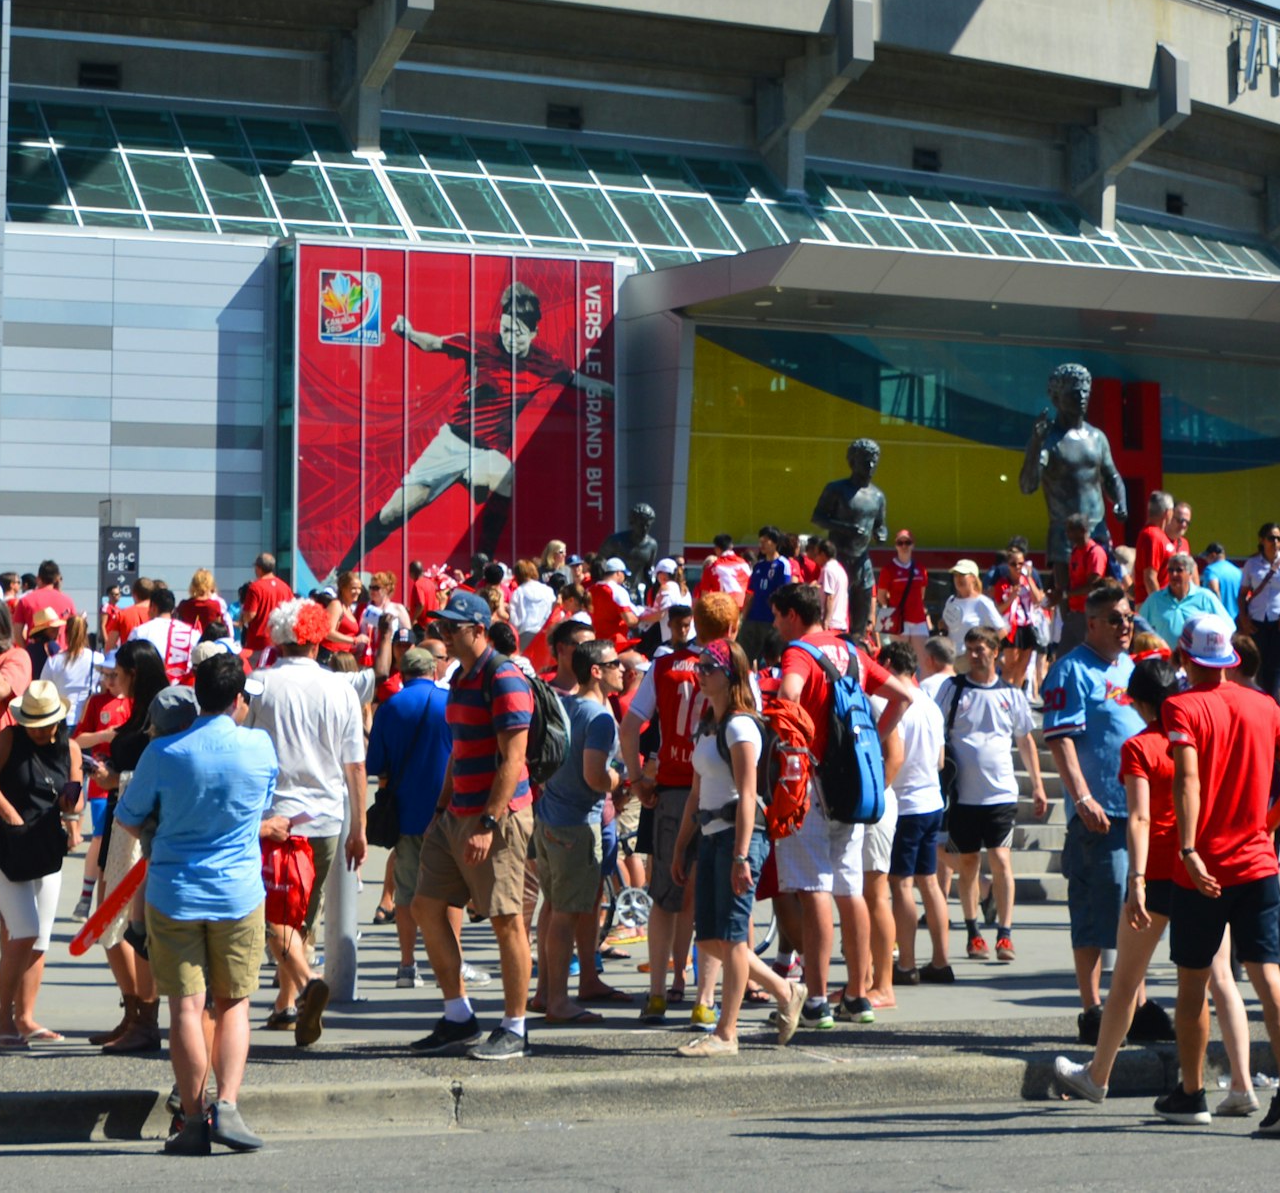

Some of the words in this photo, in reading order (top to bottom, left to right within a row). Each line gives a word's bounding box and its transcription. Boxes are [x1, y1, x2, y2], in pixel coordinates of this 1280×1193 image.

[324, 314, 357, 326] CANADA
[584, 284, 602, 340] VERS
[585, 347, 602, 374] LE
[585, 383, 603, 459] GRAND
[586, 467, 603, 512] BUT
[112, 531, 133, 539] GATES
